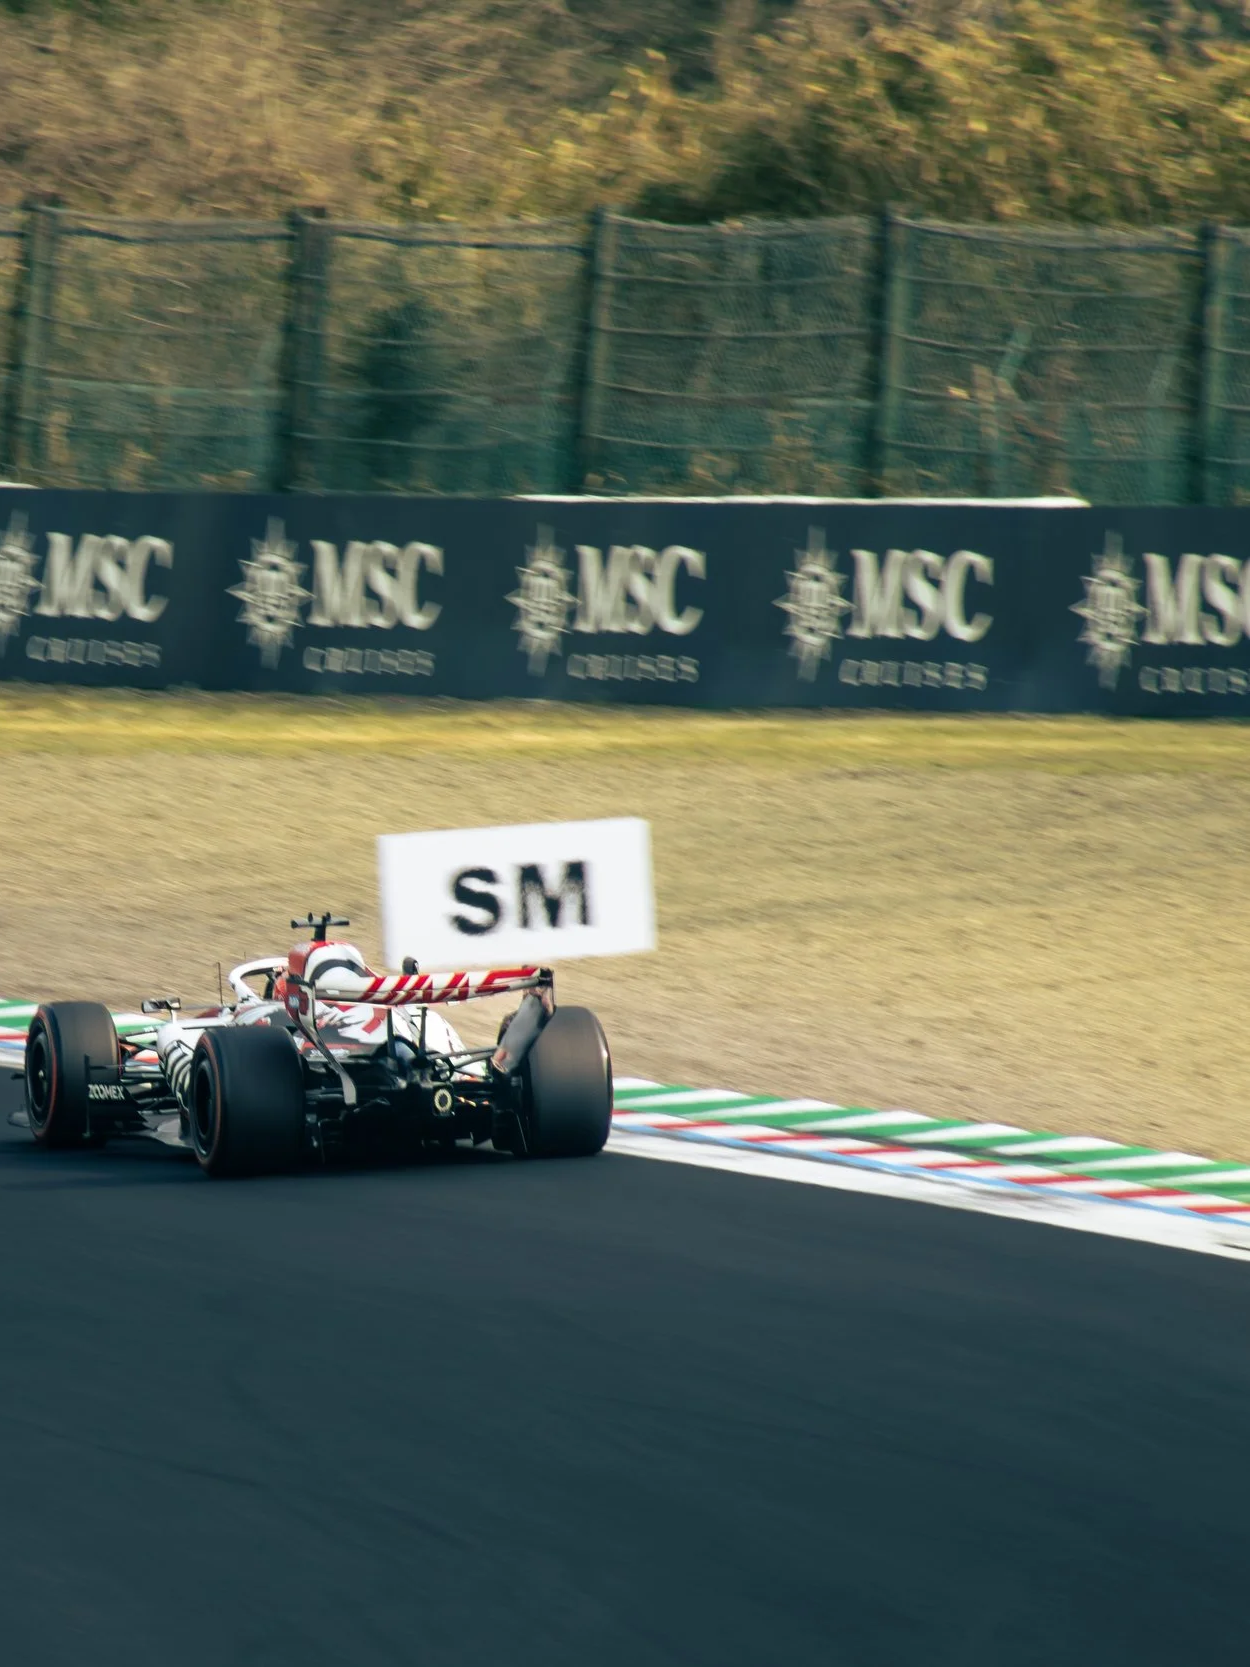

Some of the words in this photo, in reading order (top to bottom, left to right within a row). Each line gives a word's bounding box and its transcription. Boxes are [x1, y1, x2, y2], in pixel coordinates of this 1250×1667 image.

[34, 532, 174, 622] MSC
[306, 540, 444, 630] MSC
[574, 545, 706, 635] MSC
[846, 549, 994, 642] MSC
[1141, 553, 1250, 647] MS
[449, 860, 591, 936] SM
[88, 1083, 125, 1101] ZOOMEX
